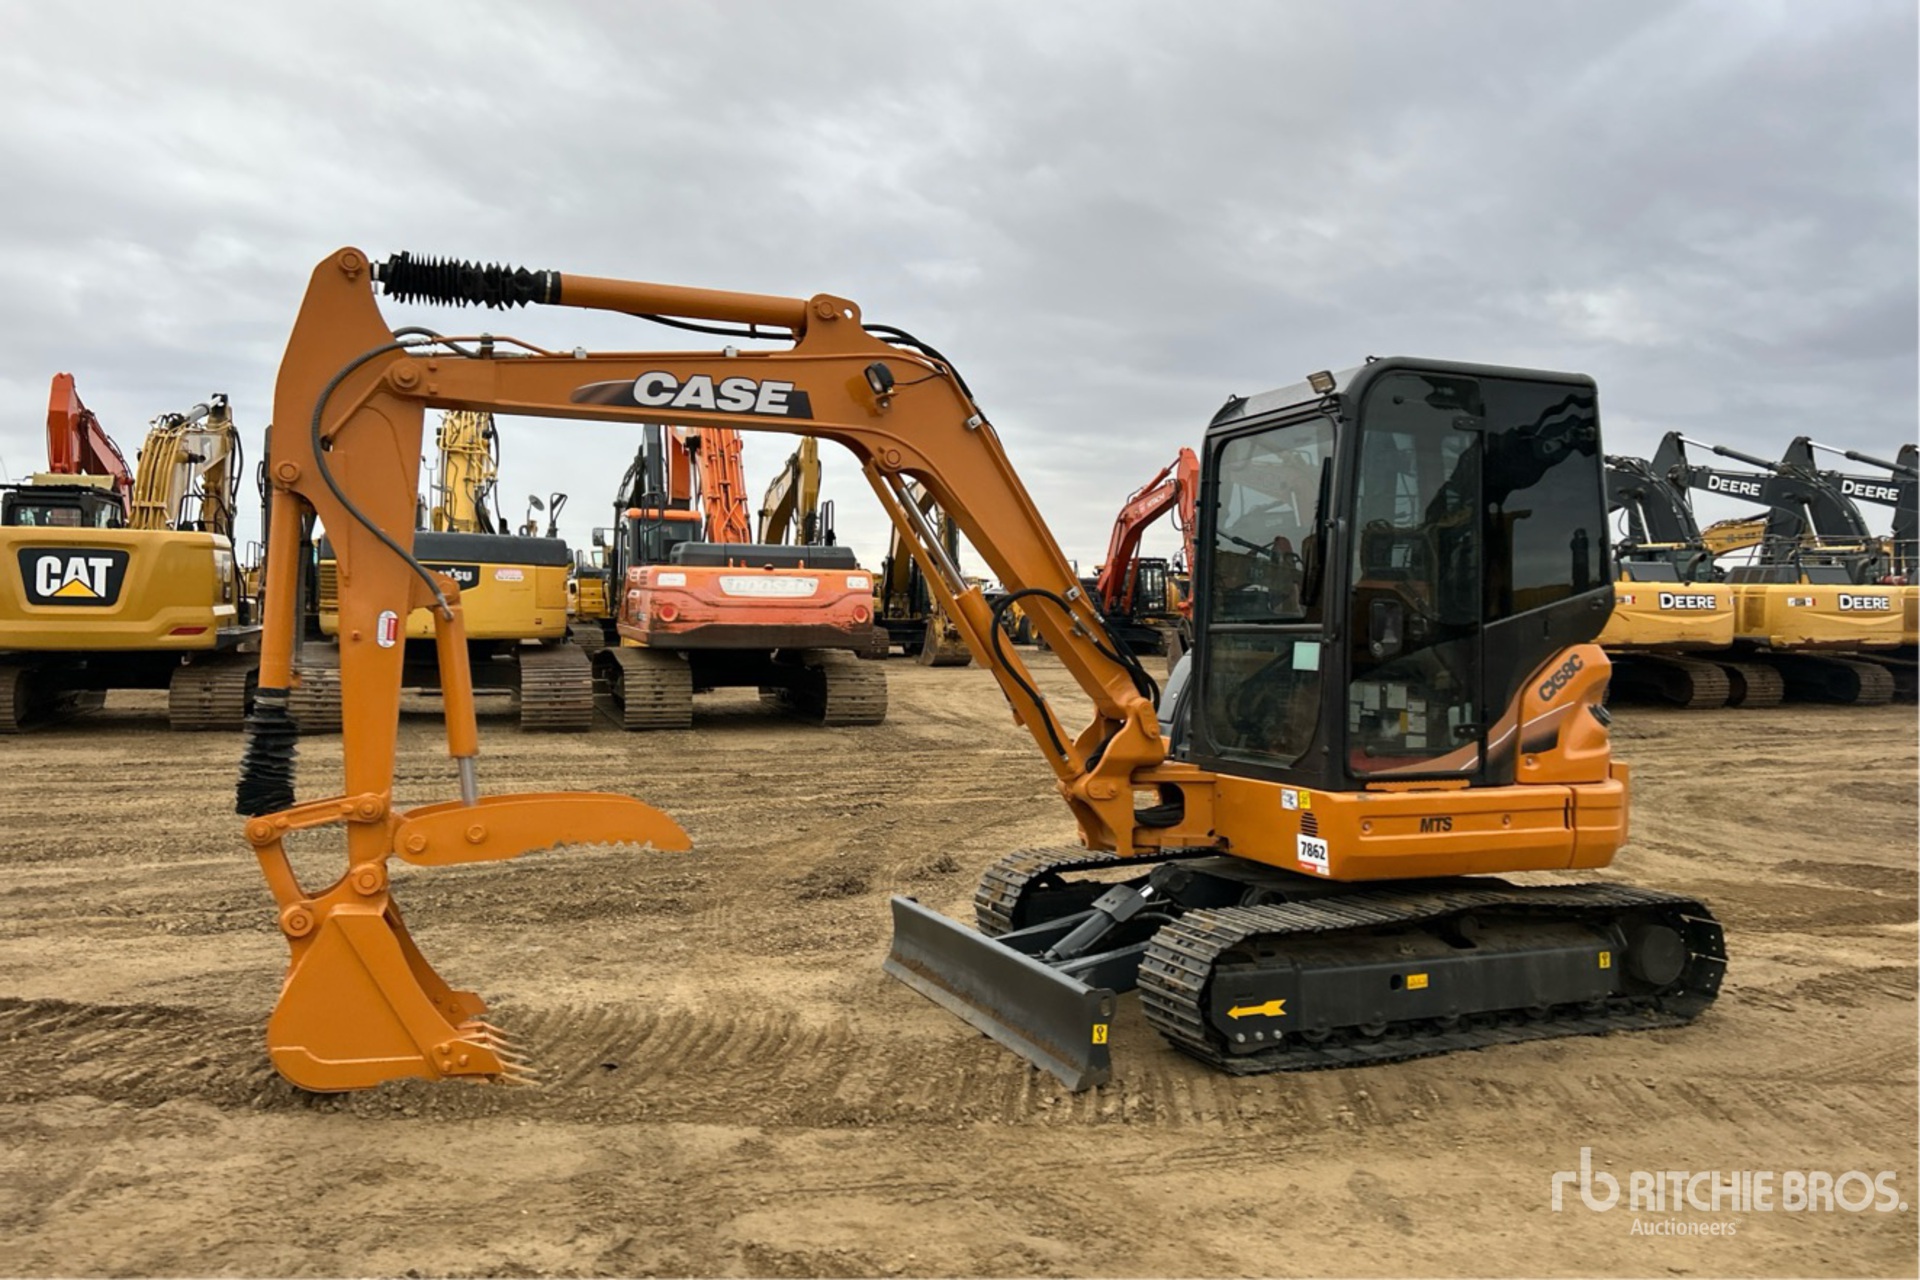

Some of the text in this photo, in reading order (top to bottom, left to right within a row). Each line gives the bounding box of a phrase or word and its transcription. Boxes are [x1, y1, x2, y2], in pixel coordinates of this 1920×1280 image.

[633, 371, 794, 415] CASE
[1708, 475, 1761, 496] DEERE
[1841, 480, 1899, 501] DEERE
[36, 555, 113, 598] CAT
[1659, 592, 1716, 609] DEERE
[1838, 594, 1889, 611] DEERE
[1539, 654, 1583, 701] CX58C
[1420, 817, 1453, 833] MTS
[1300, 841, 1326, 861] 7862
